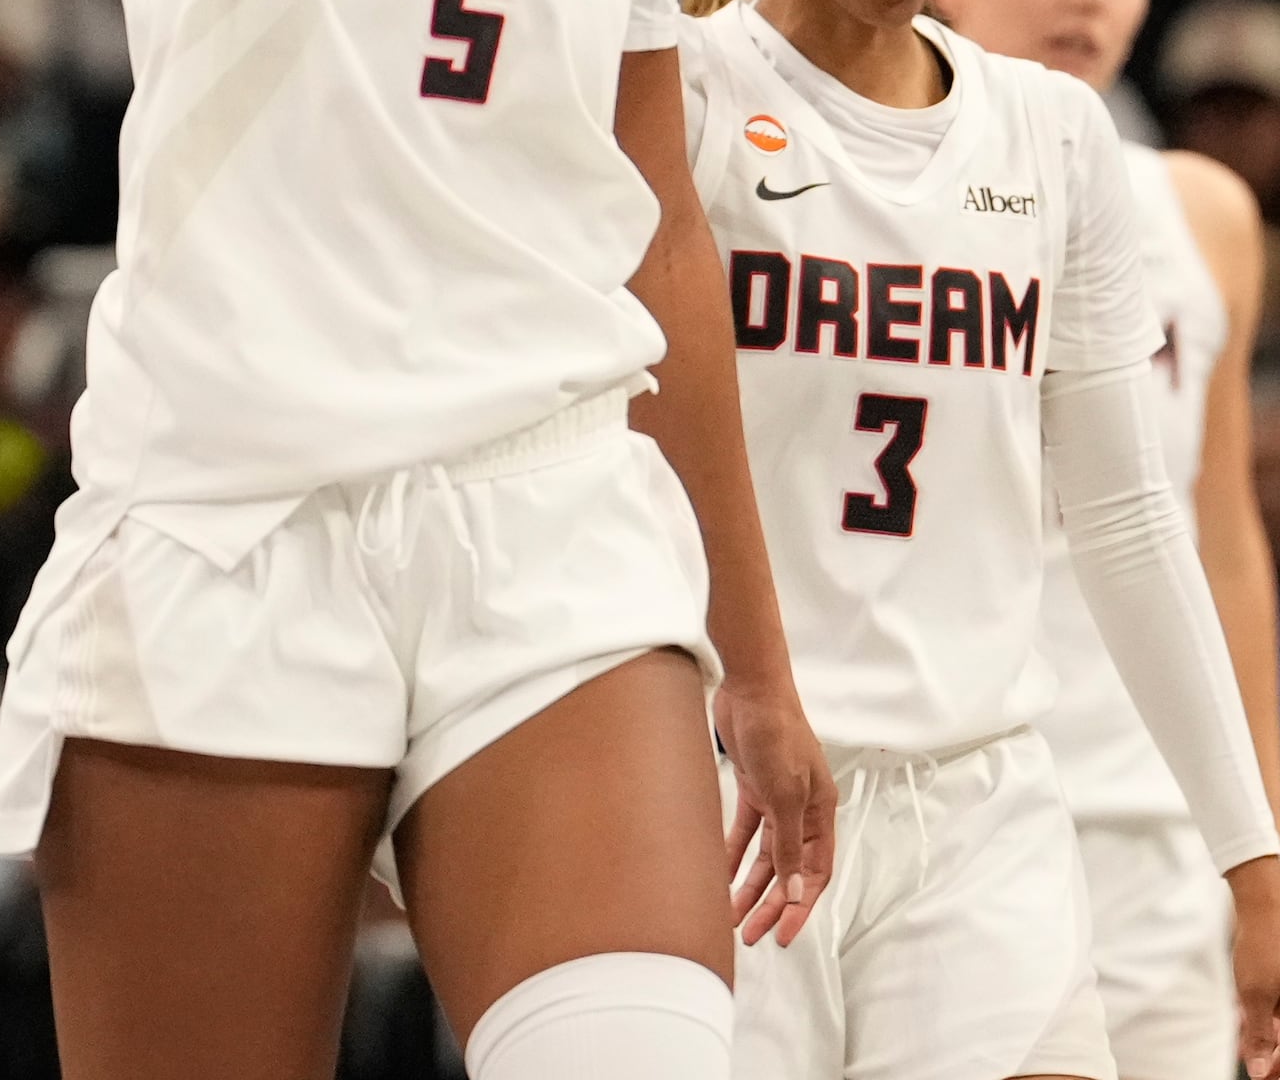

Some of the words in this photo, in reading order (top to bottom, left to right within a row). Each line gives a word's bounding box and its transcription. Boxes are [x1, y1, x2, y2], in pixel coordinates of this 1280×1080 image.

[963, 184, 1036, 218] Albert
[729, 249, 1040, 377] DREAM
[841, 392, 928, 538] 3
